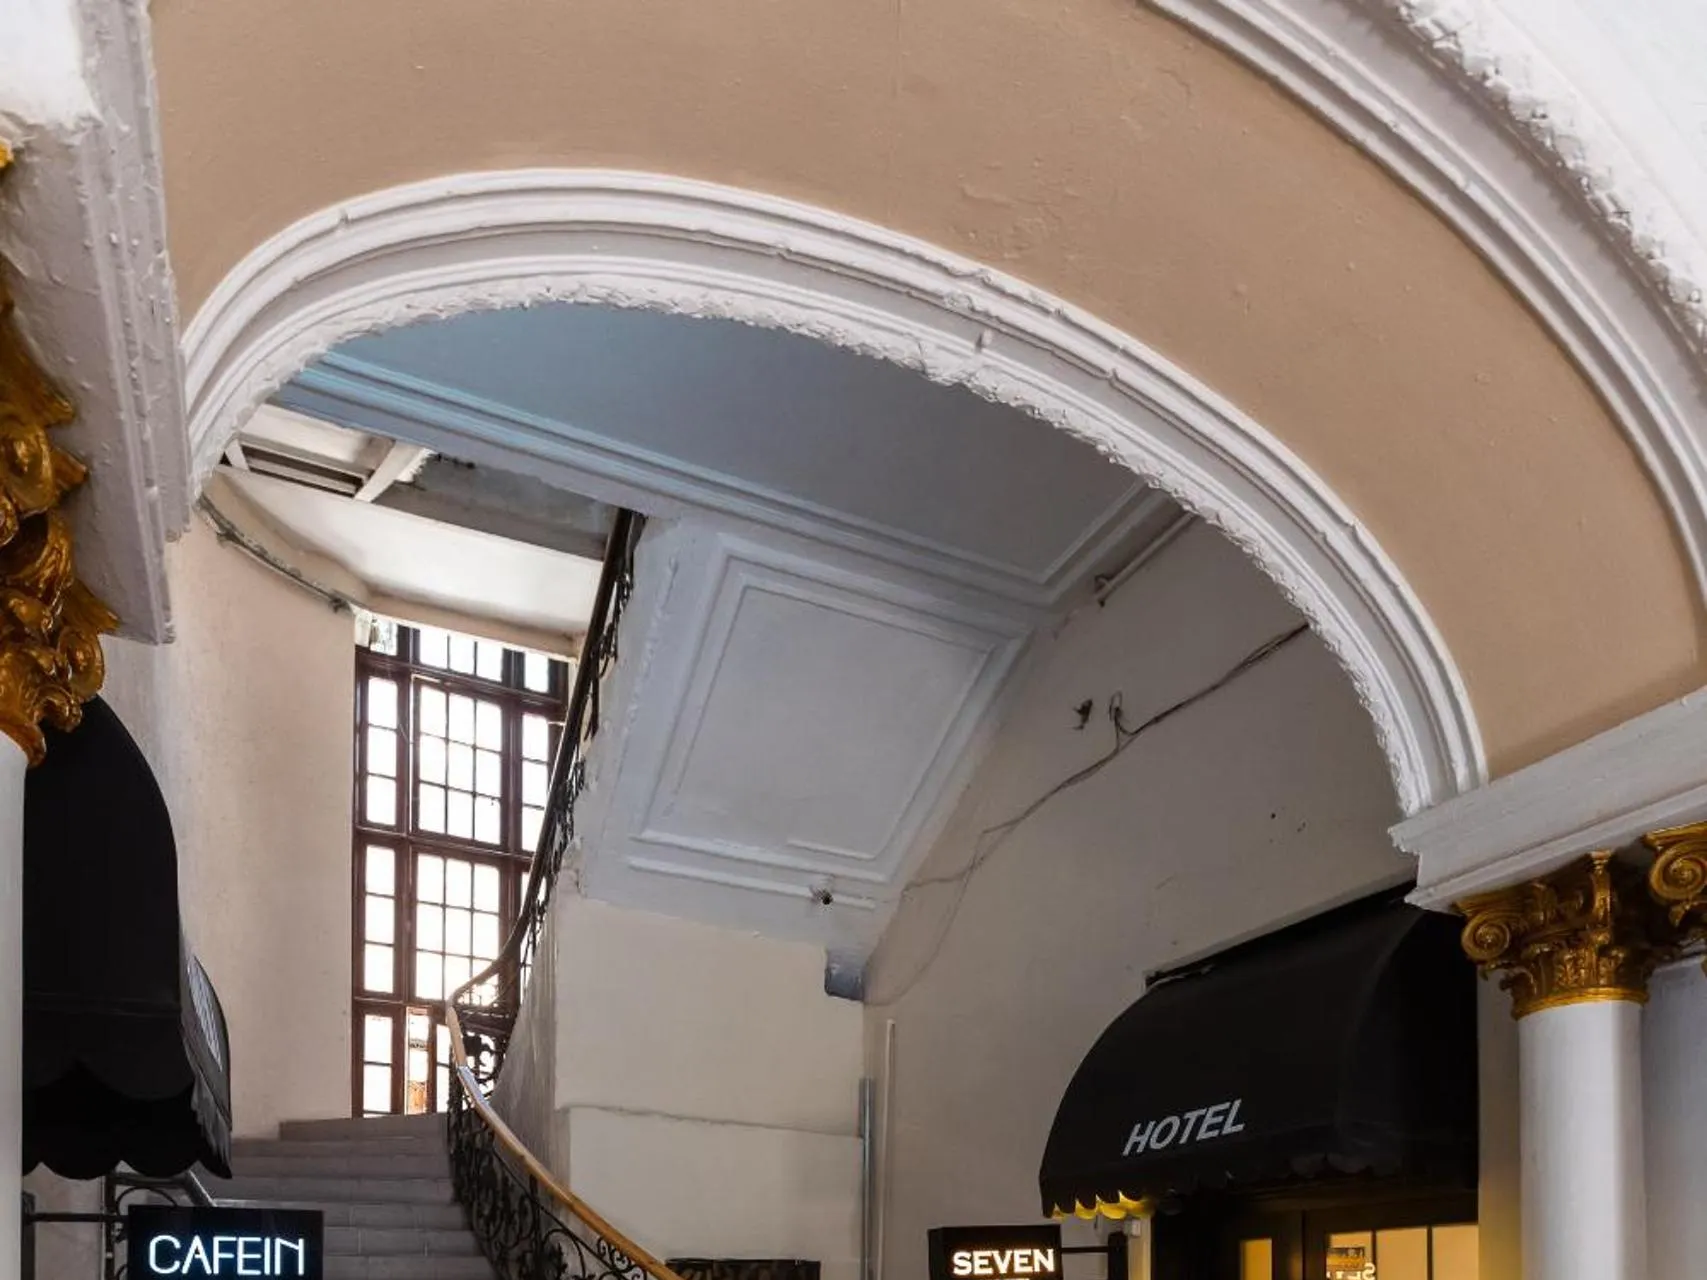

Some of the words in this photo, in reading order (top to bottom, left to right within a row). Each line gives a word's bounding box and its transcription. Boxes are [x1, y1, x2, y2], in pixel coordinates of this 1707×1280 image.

[1122, 1099, 1245, 1156] HOTEL
[148, 1234, 304, 1276] CAFEIN
[952, 1248, 1055, 1276] SEVEN
